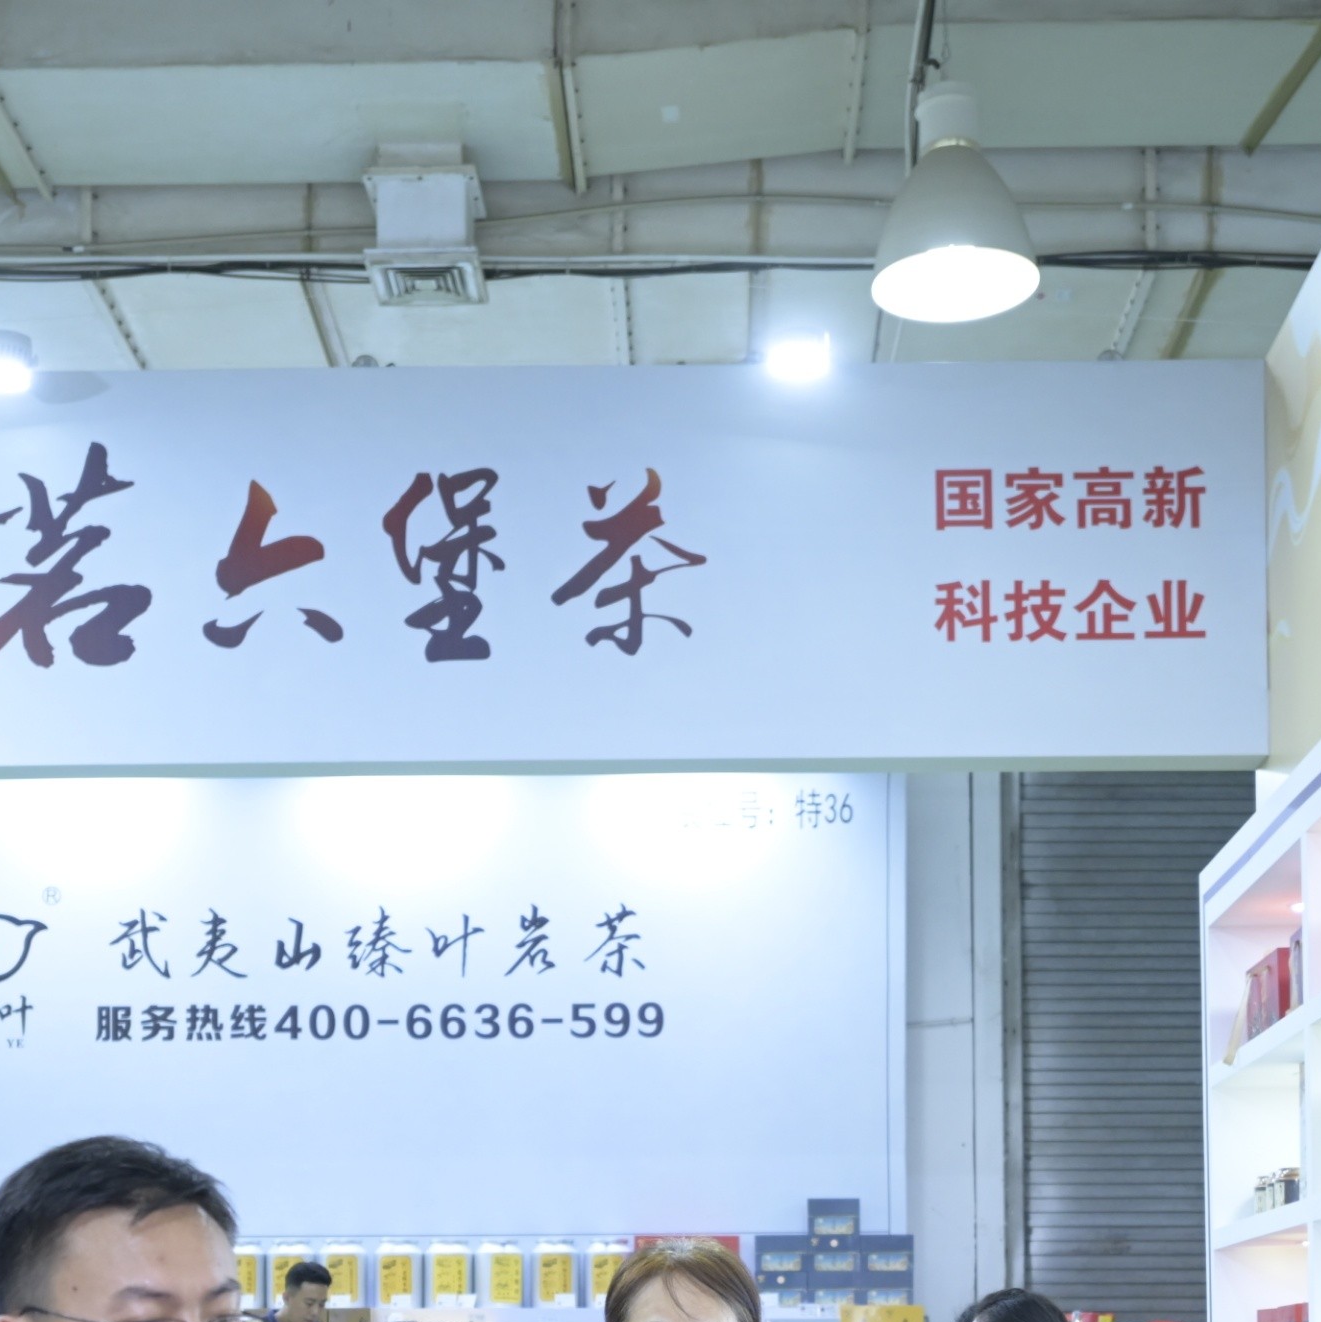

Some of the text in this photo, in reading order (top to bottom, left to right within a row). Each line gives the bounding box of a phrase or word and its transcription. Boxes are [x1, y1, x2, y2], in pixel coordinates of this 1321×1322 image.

[933, 465, 1207, 531] 国家高新
[933, 578, 1207, 643] 科技企业
[108, 902, 650, 981] 武夷山臻叶岩茶
[6, 1038, 25, 1049] YE
